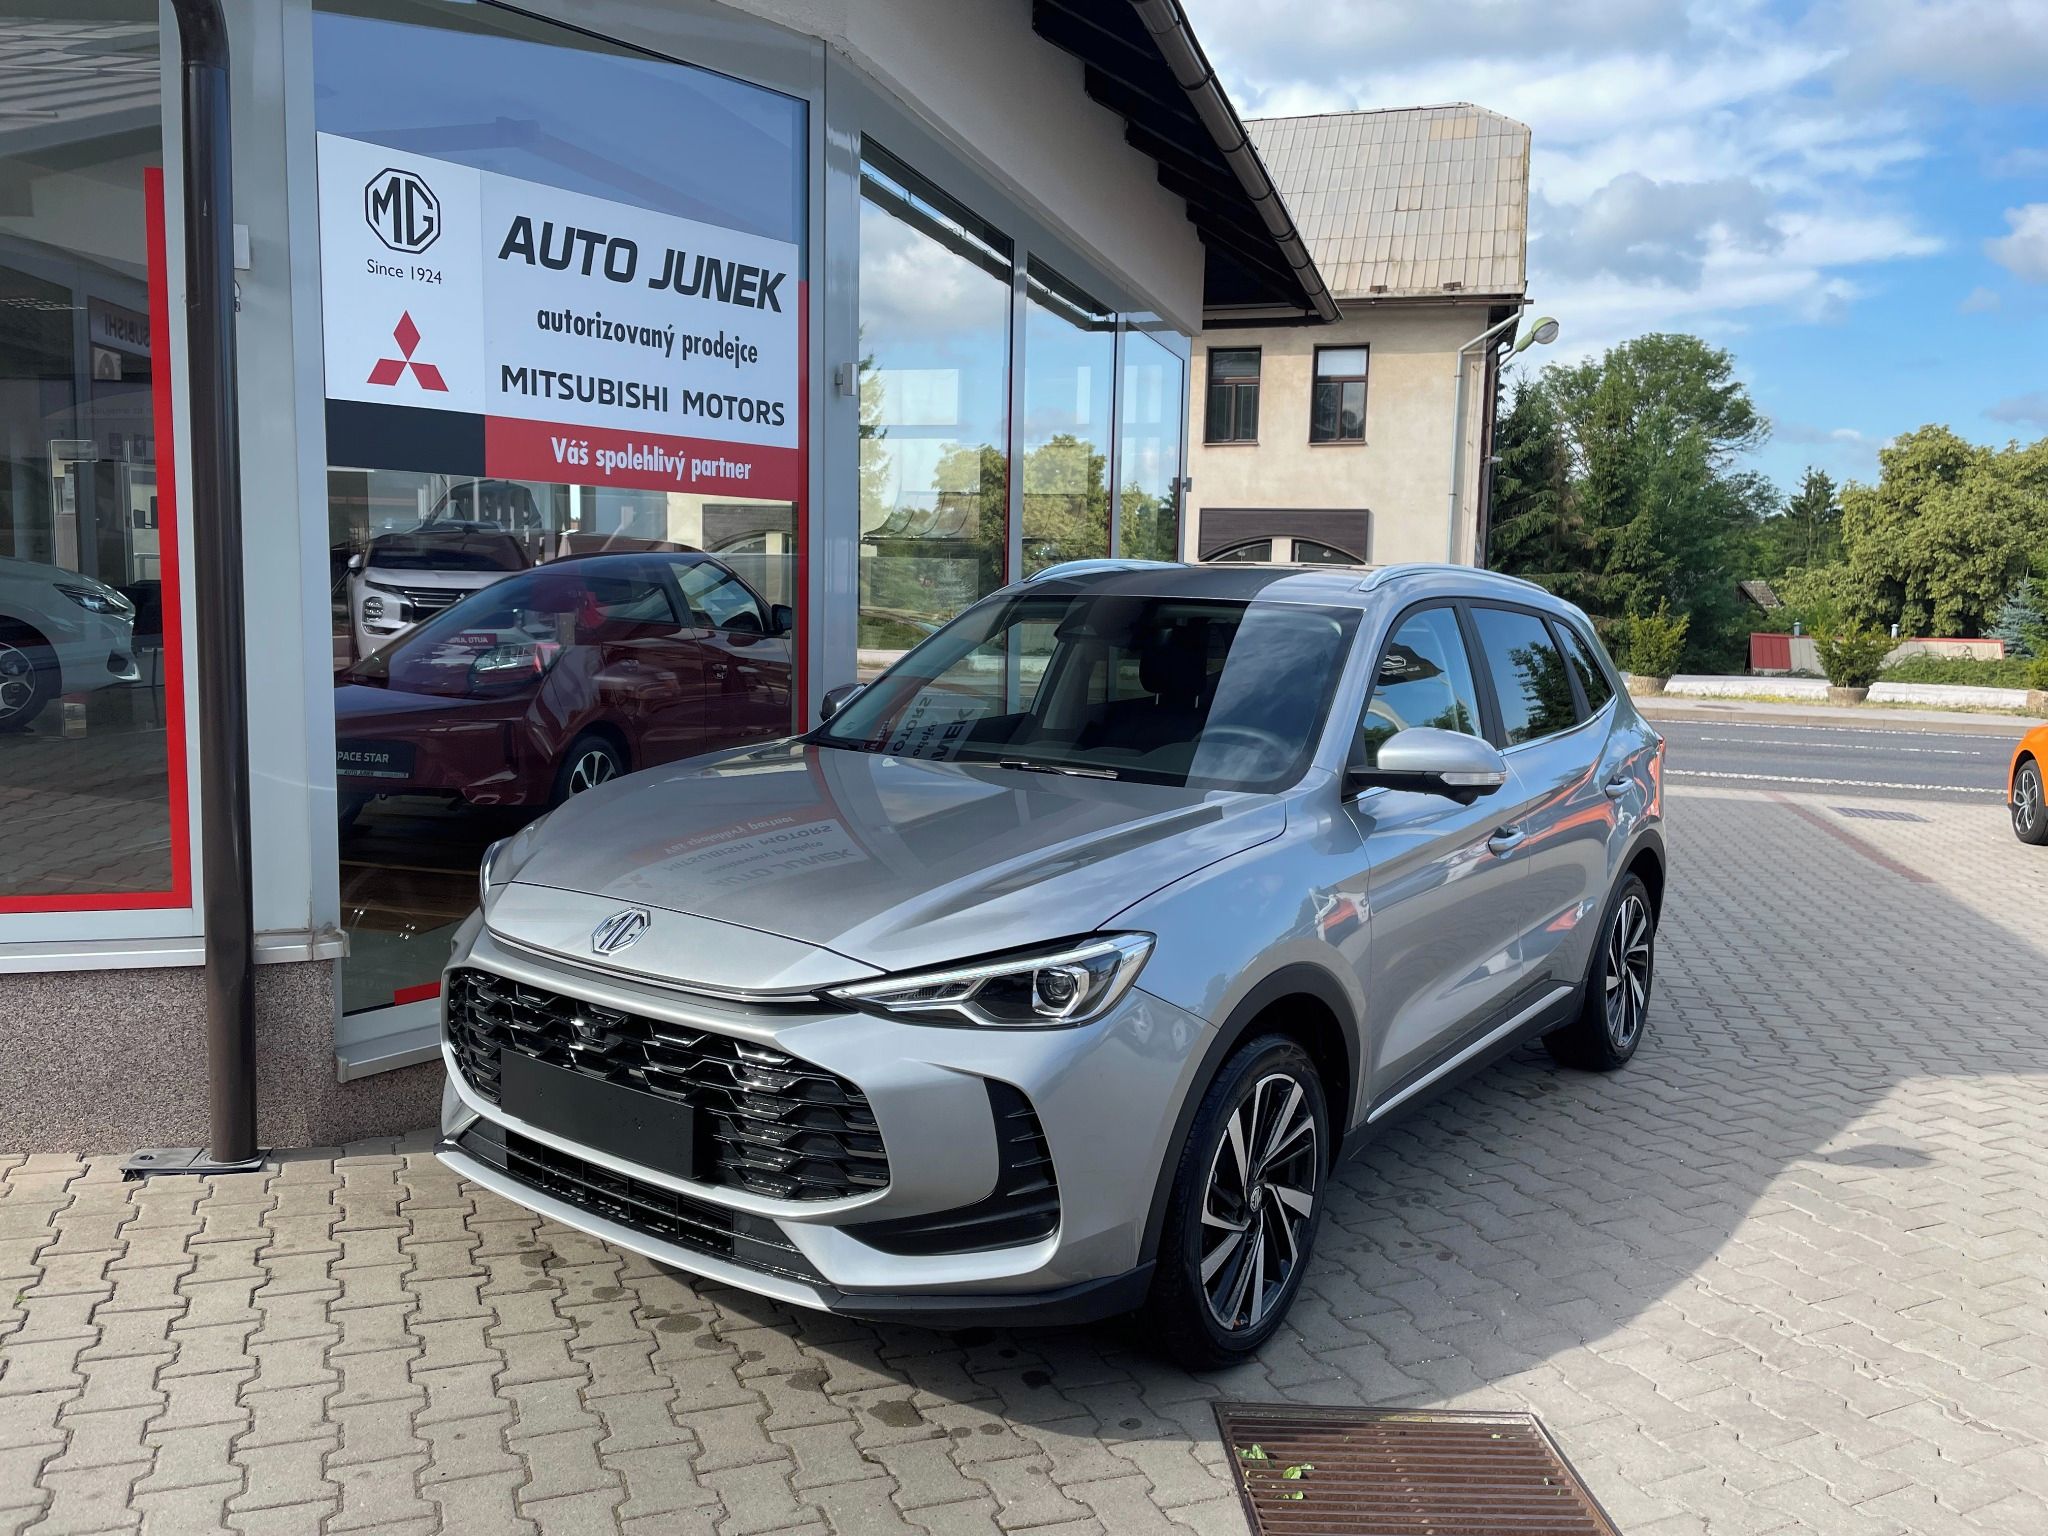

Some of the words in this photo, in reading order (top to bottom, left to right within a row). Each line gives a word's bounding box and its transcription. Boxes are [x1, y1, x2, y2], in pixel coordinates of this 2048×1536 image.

[371, 175, 435, 247] MG
[367, 258, 404, 278] Since
[411, 265, 442, 284] 1924
[498, 215, 638, 283] AUTO
[648, 248, 786, 313] JUNEK
[537, 308, 675, 358] autorizovaný
[682, 330, 758, 369] prodejce
[501, 364, 668, 412] MITSUBISHI
[682, 389, 785, 426] MOTORS
[551, 436, 589, 466] Váš
[595, 443, 685, 481] spolehlivý
[691, 456, 752, 482] partner
[337, 751, 362, 761] PACE
[363, 752, 390, 763] STAR
[594, 909, 649, 953] MG
